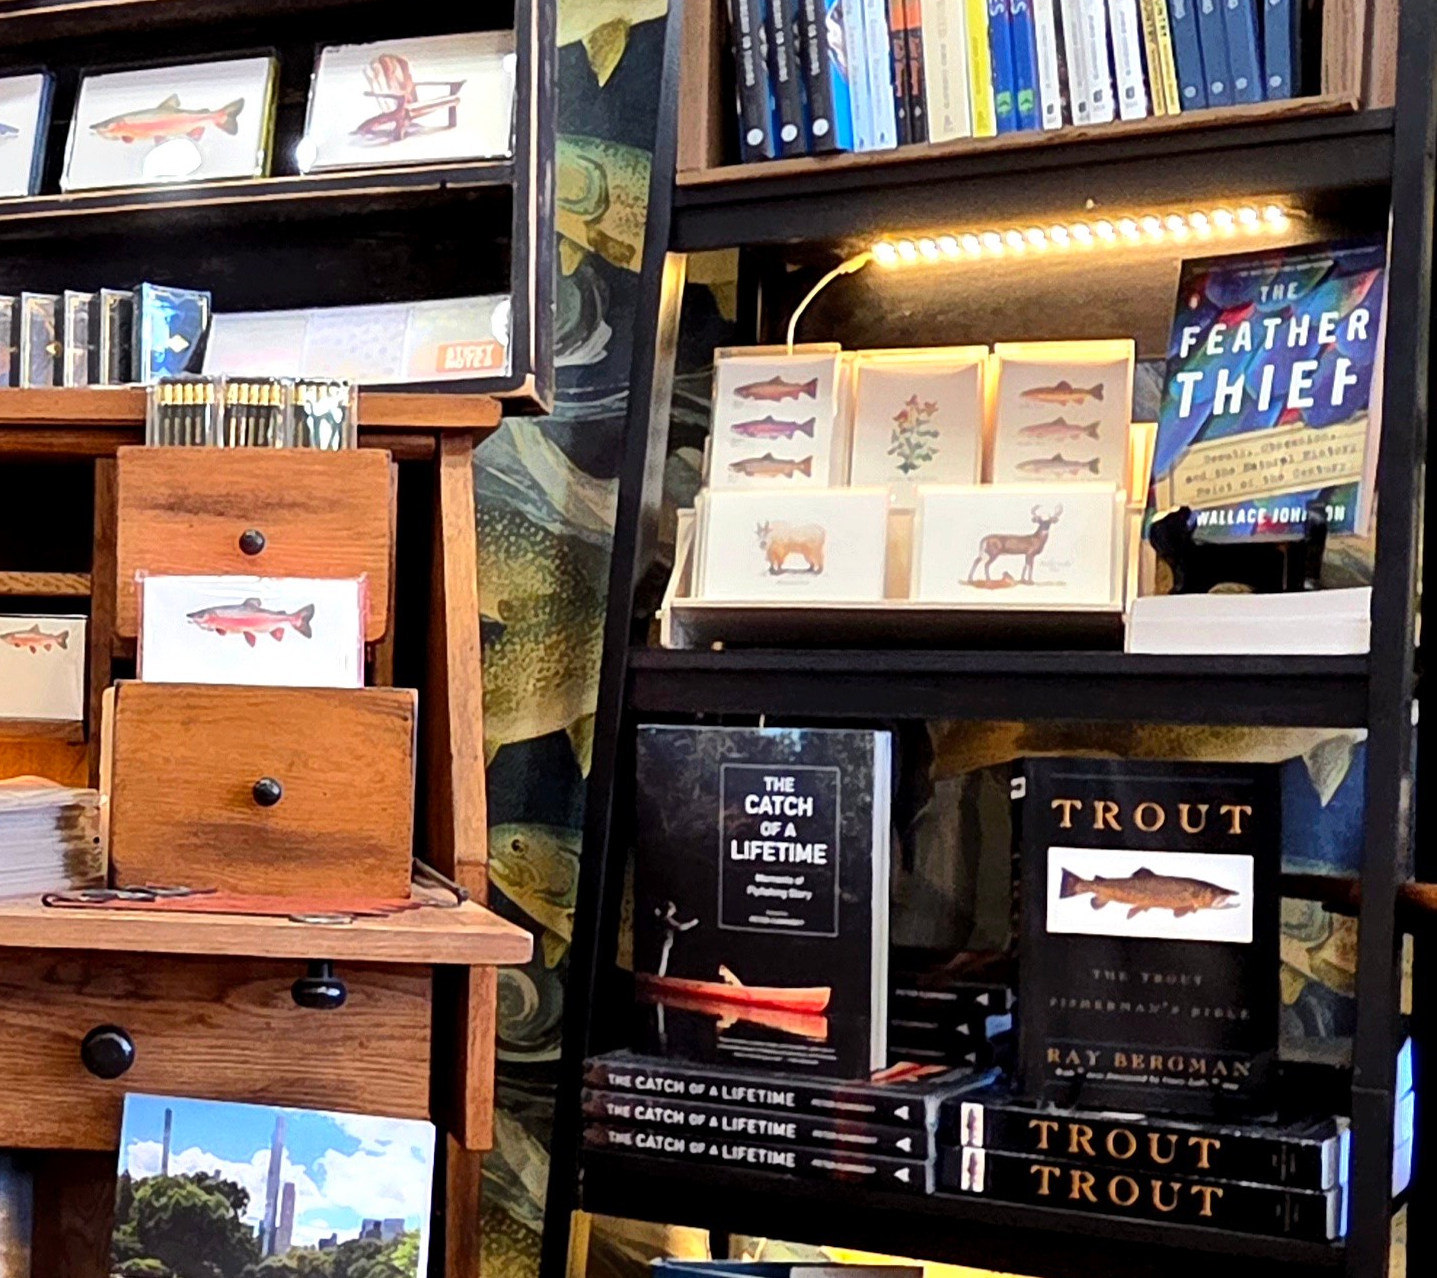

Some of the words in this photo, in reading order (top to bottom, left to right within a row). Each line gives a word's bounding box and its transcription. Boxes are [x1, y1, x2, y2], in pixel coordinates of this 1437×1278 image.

[1259, 281, 1299, 302] THE
[1179, 307, 1370, 359] FEATHER
[1176, 357, 1359, 419] THIEF
[1197, 507, 1266, 526] WALLACE
[763, 776, 795, 792] THE
[745, 794, 813, 817] CATCH
[1051, 799, 1252, 834] TROUT
[760, 821, 782, 837] OF
[784, 822, 797, 837] A
[730, 839, 828, 865] LIFETIME
[1047, 1048, 1100, 1066] RAY
[1114, 1052, 1251, 1077] BERGMAN
[608, 1074, 631, 1088] THE
[634, 1076, 684, 1094] CATCH
[688, 1083, 706, 1095] OF
[709, 1085, 718, 1097] A
[721, 1086, 796, 1107] LIFETIME
[1028, 1119, 1221, 1169] TROUT
[1030, 1164, 1224, 1216] TROUT
